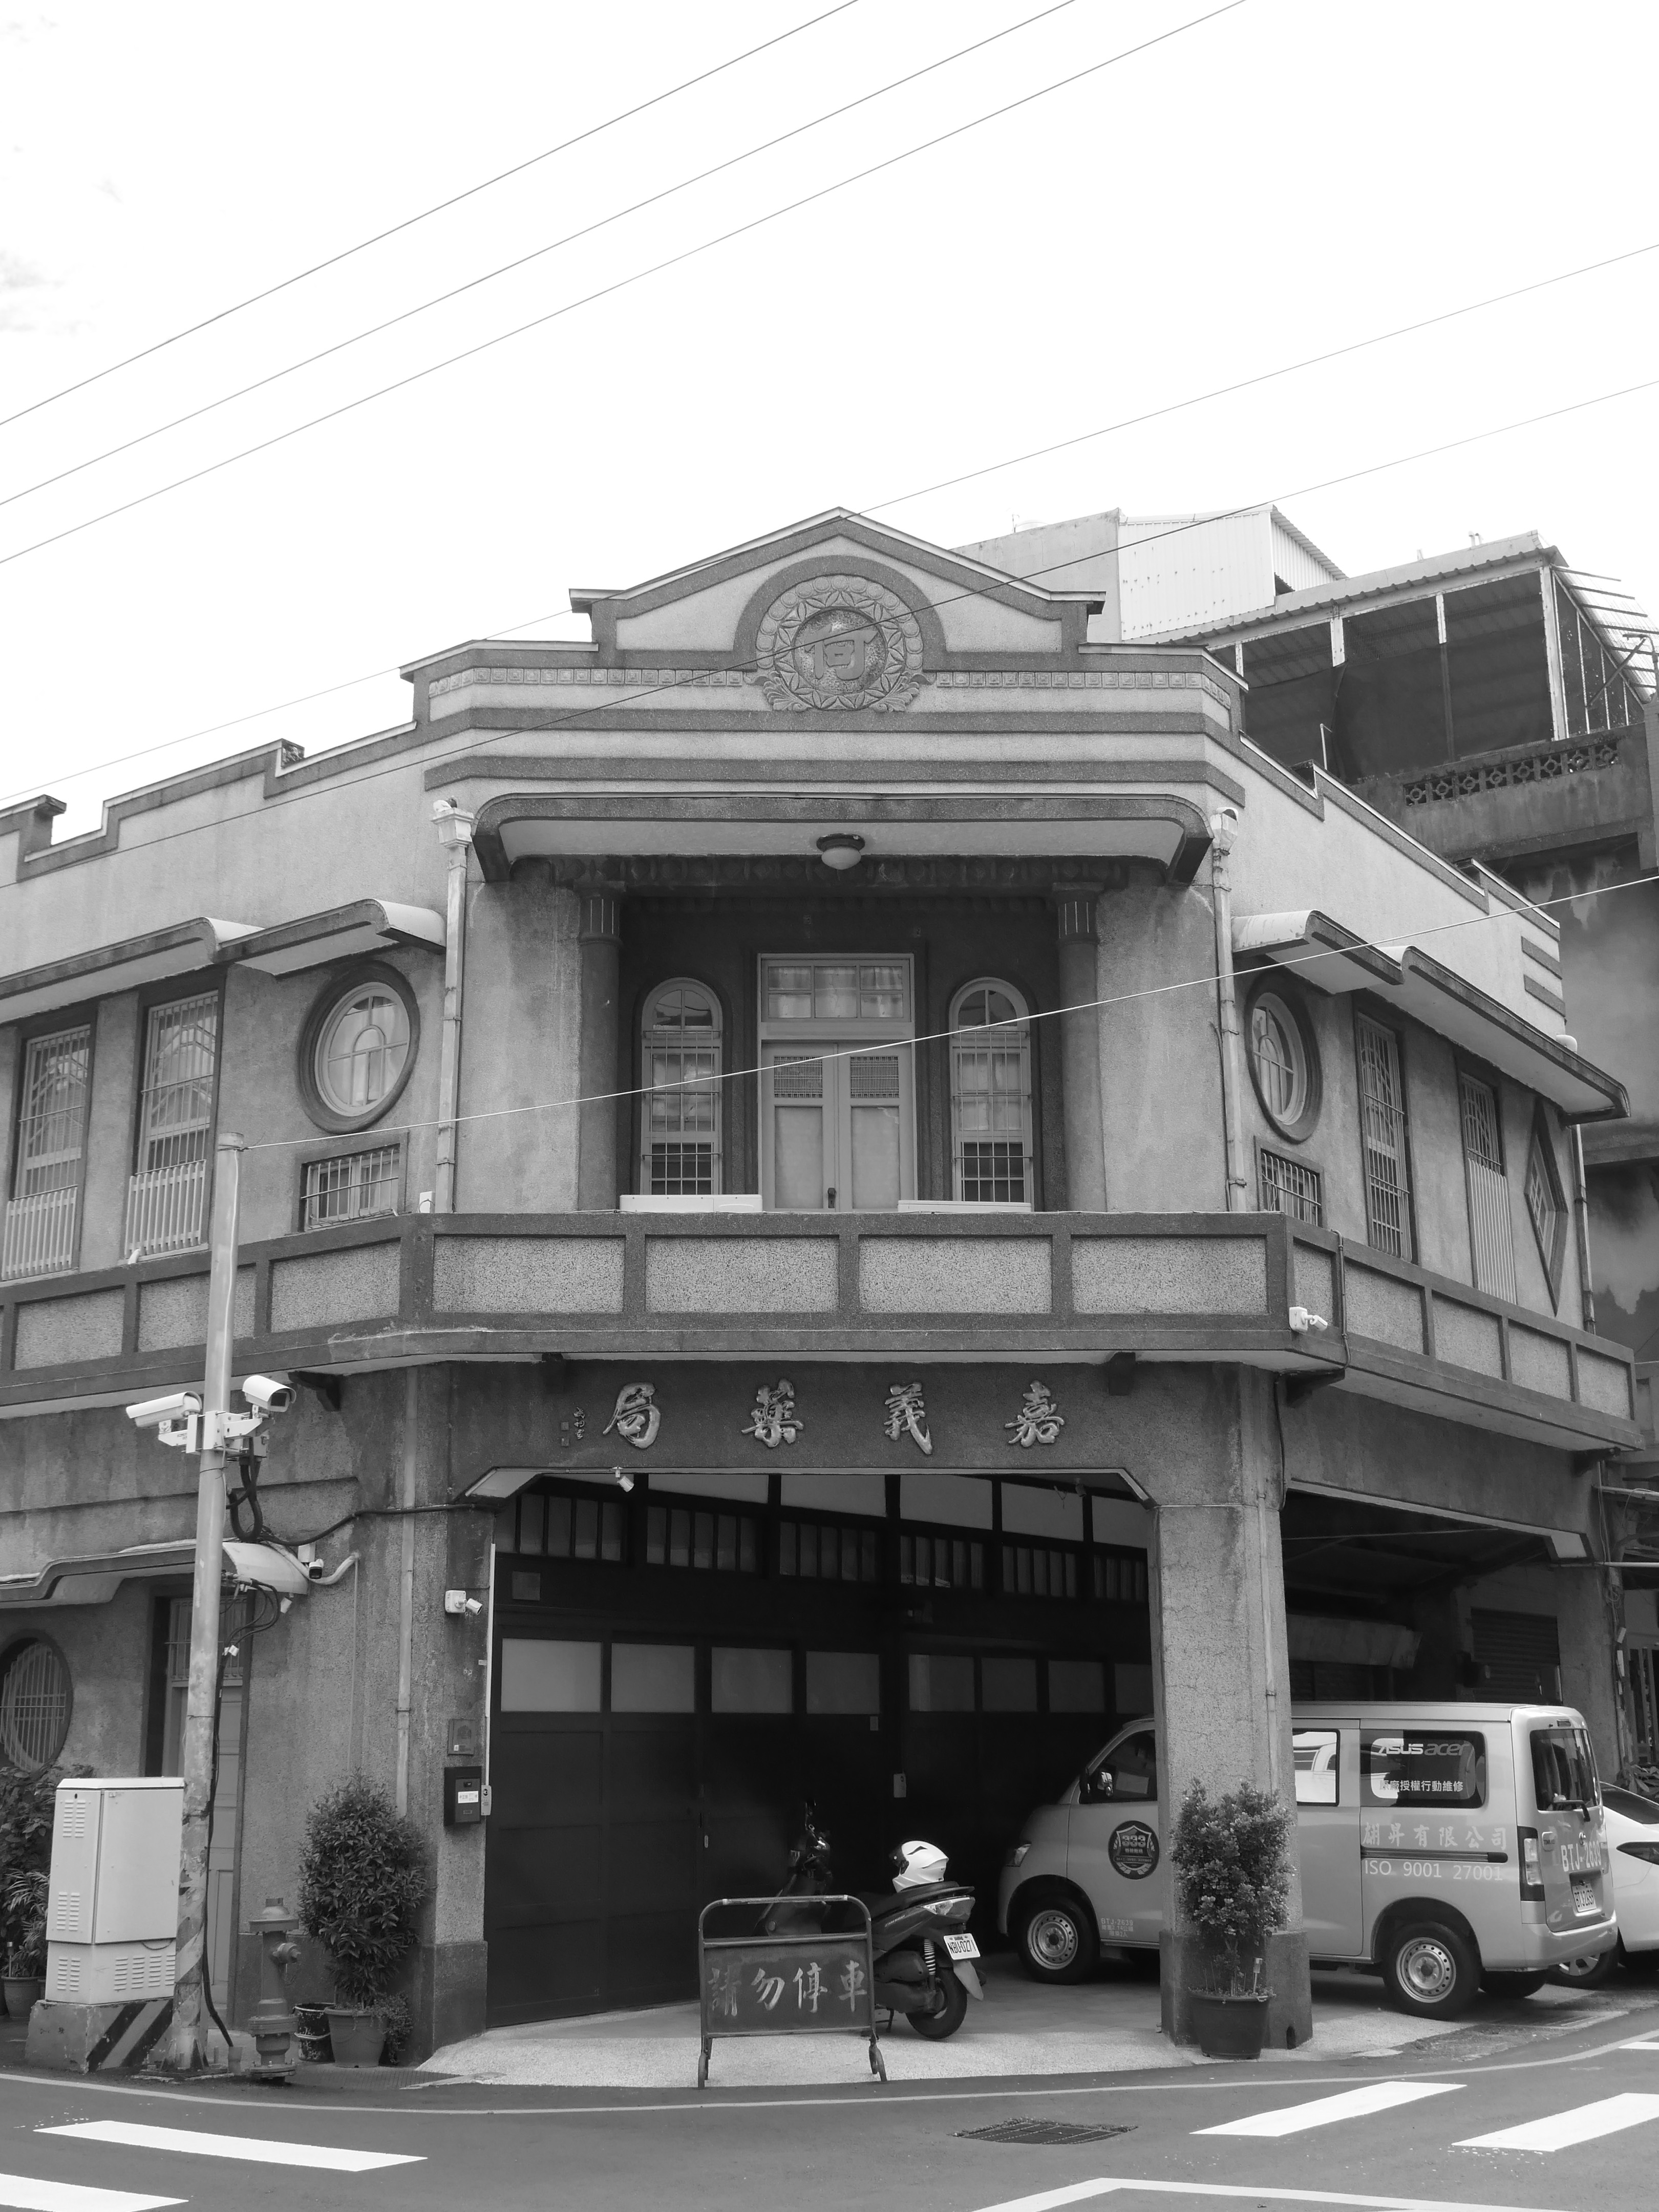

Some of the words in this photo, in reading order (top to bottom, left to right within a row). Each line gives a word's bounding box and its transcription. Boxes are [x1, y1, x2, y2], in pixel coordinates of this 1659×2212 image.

[1377, 1743, 1423, 1756] ASUS
[1424, 1743, 1470, 1756] acer
[1379, 1780, 1463, 1792] 原廠授權行動維修
[1121, 1835, 1146, 1848] 333
[1365, 1860, 1392, 1876] ISO
[1403, 1861, 1442, 1878] 9001
[1453, 1864, 1503, 1881] 27001
[1101, 1917, 1134, 1926] BTJ-2639
[947, 1940, 977, 1954] NBU-0271
[708, 1960, 867, 2016] 請勿停車
